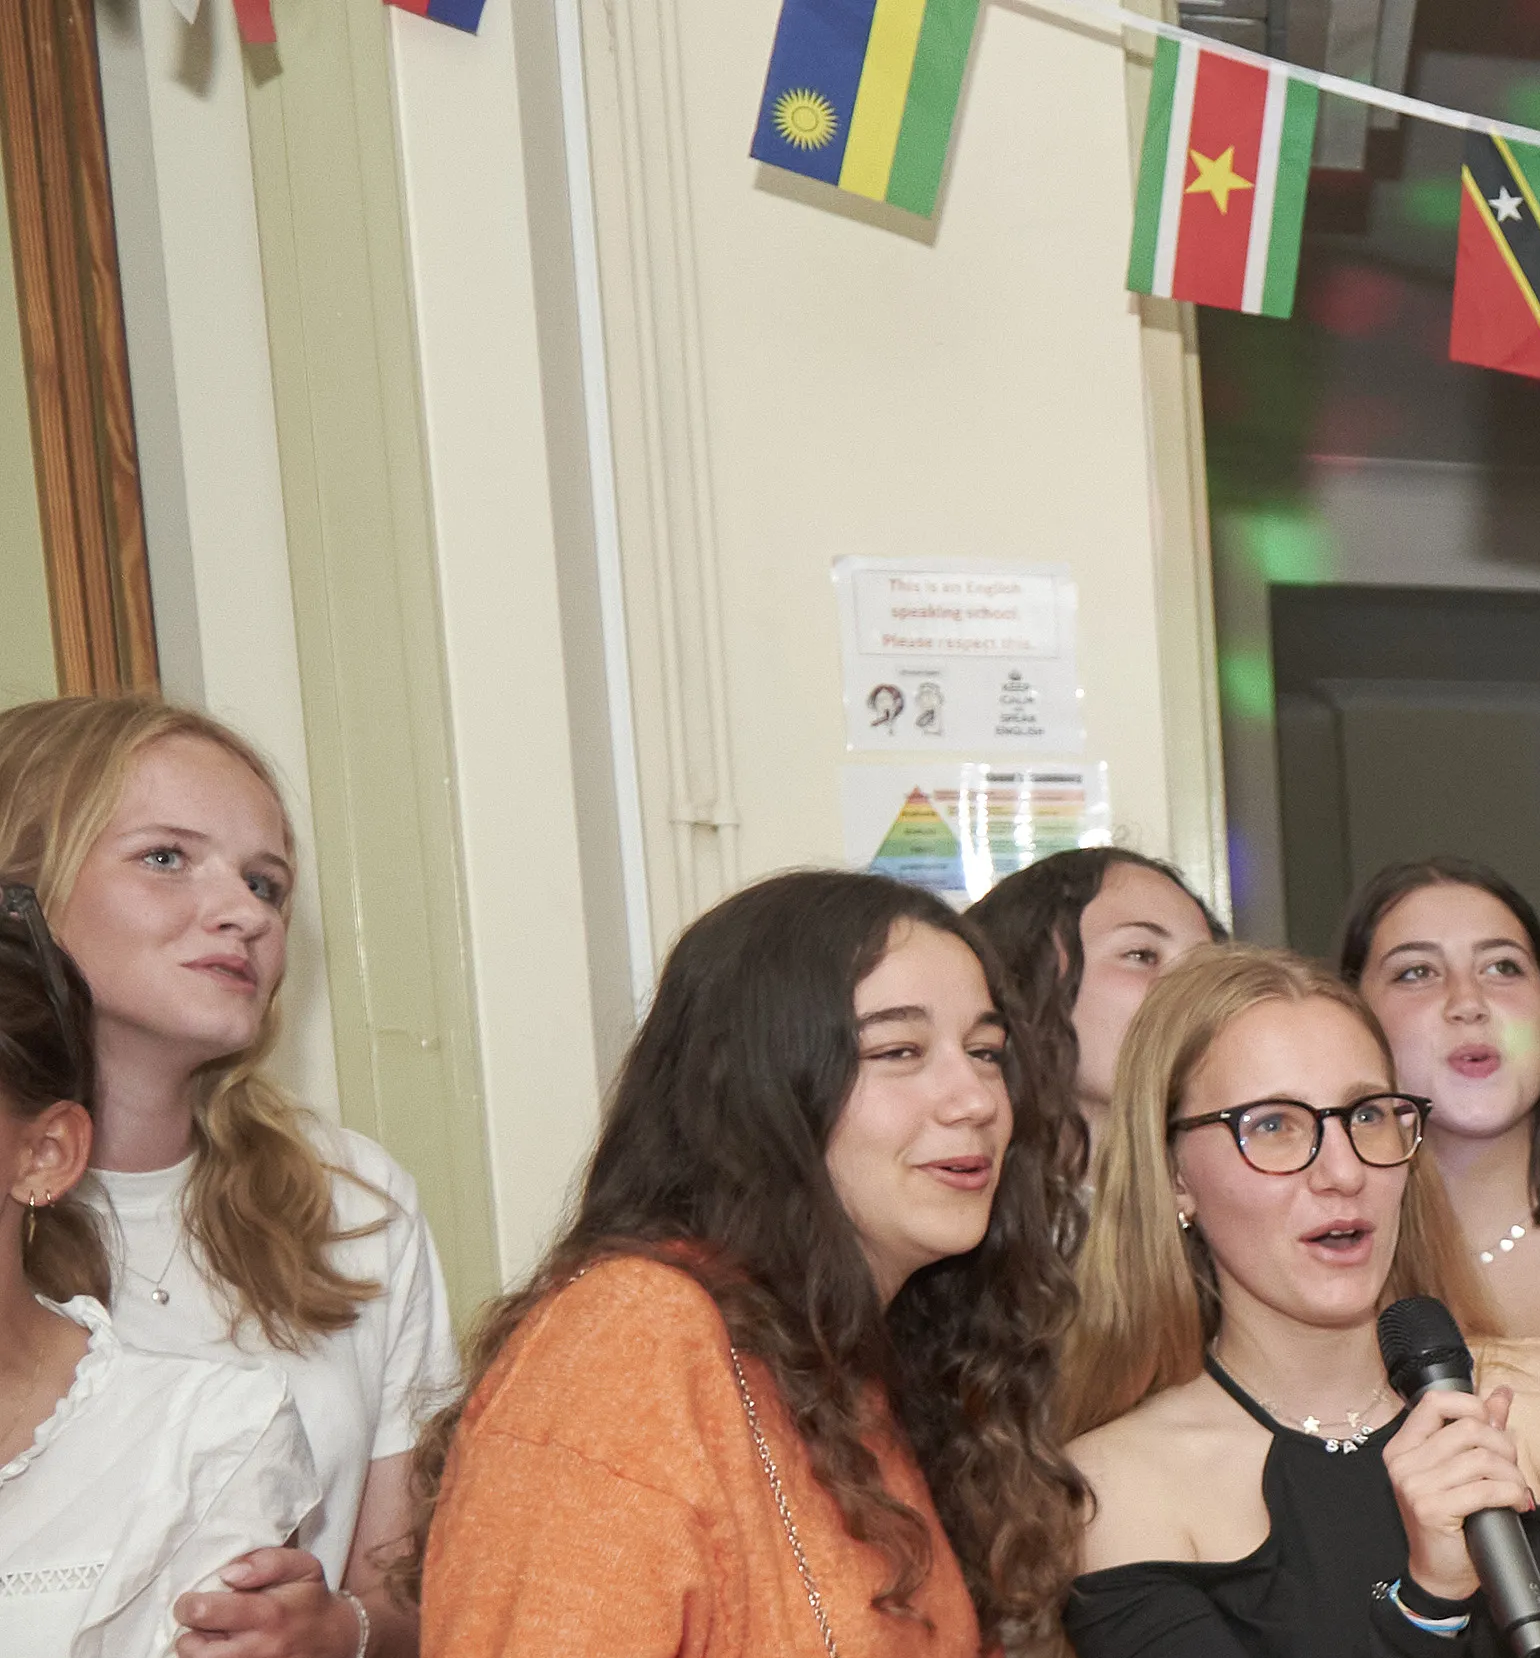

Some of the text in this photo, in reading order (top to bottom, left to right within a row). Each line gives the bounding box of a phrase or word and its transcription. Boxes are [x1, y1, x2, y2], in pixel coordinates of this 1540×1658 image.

[889, 578, 1021, 597] This is an English
[891, 604, 963, 621] speaking
[882, 633, 933, 648] Please
[938, 638, 996, 651] respect
